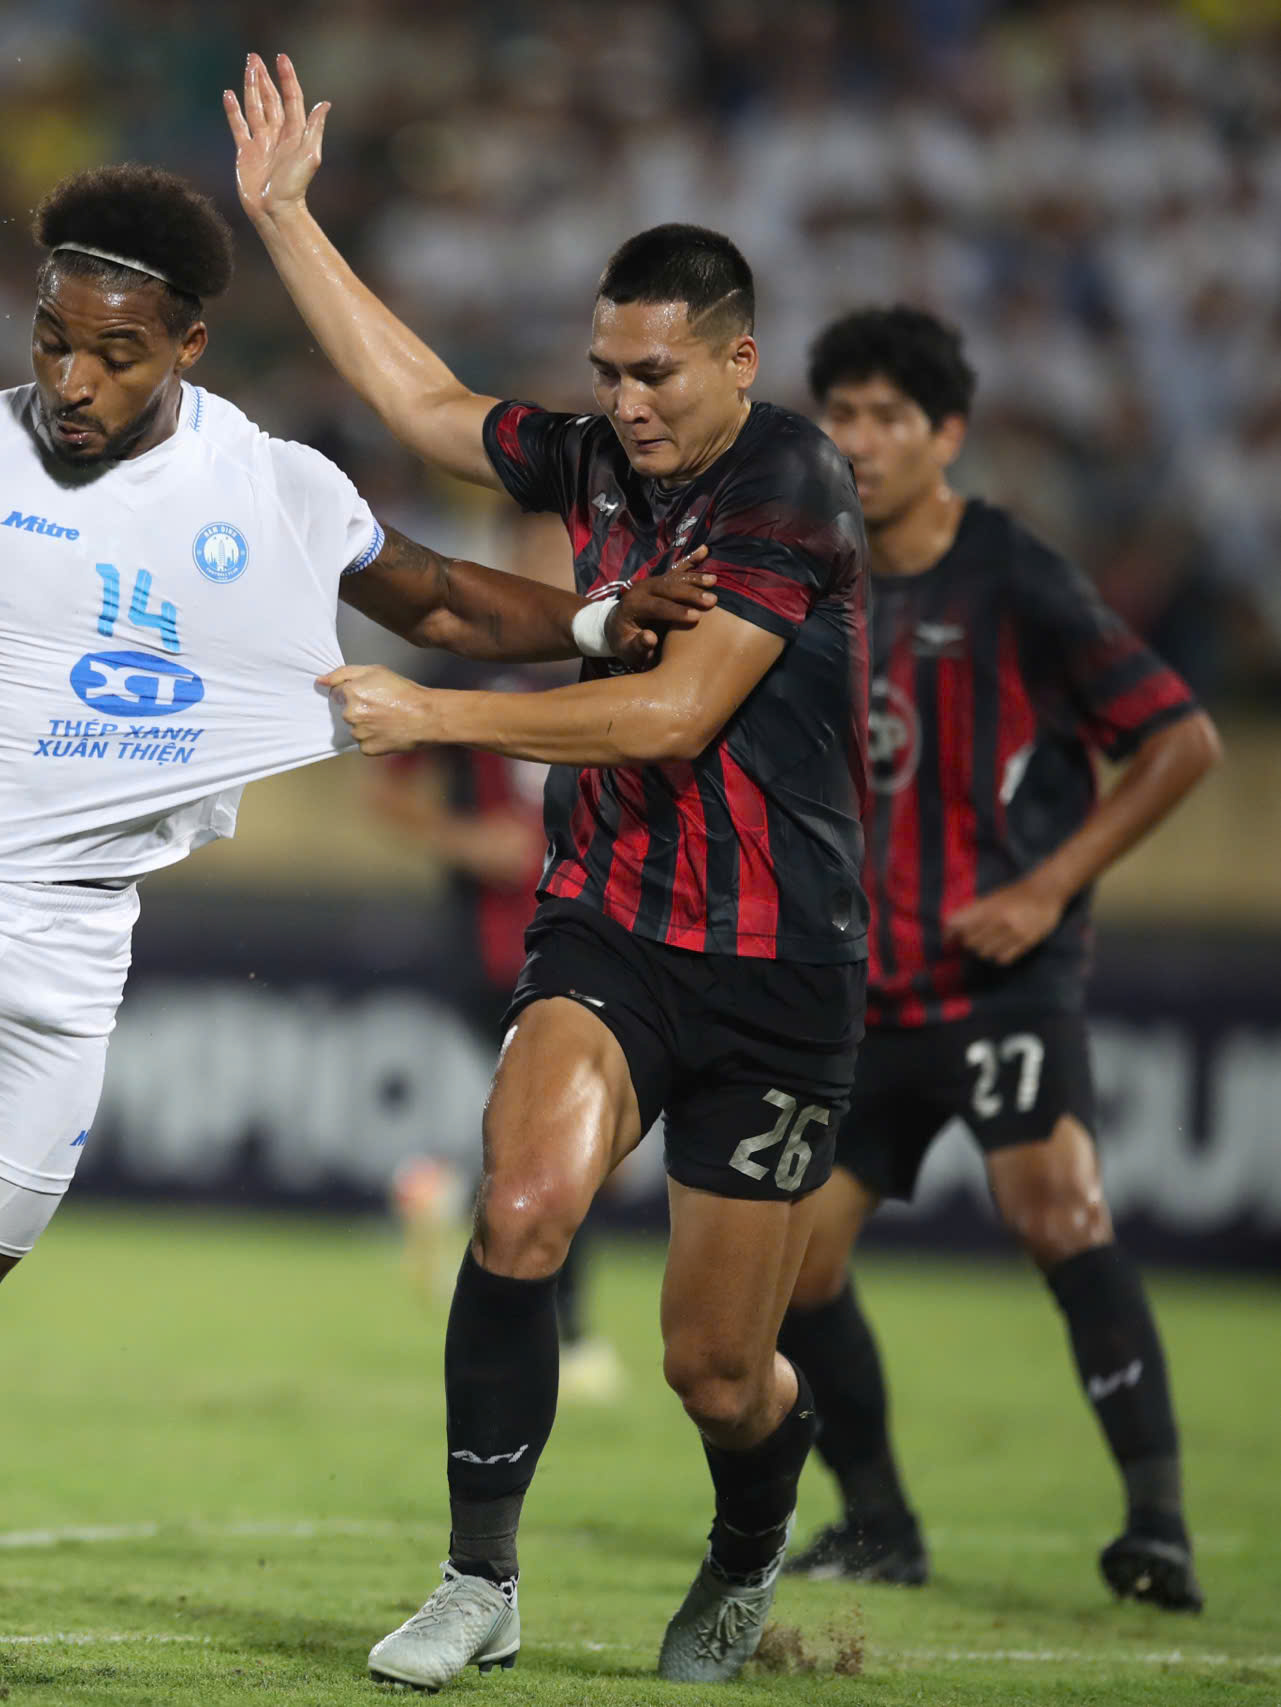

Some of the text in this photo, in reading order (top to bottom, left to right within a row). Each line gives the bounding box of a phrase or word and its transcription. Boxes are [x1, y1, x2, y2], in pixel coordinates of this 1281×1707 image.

[0, 511, 80, 541] Mitre
[95, 563, 181, 654] 14
[33, 738, 196, 767] XUÂN THIỆN
[48, 719, 206, 743] THÉP XANH
[965, 1033, 1045, 1118] 27
[728, 1088, 831, 1192] 26
